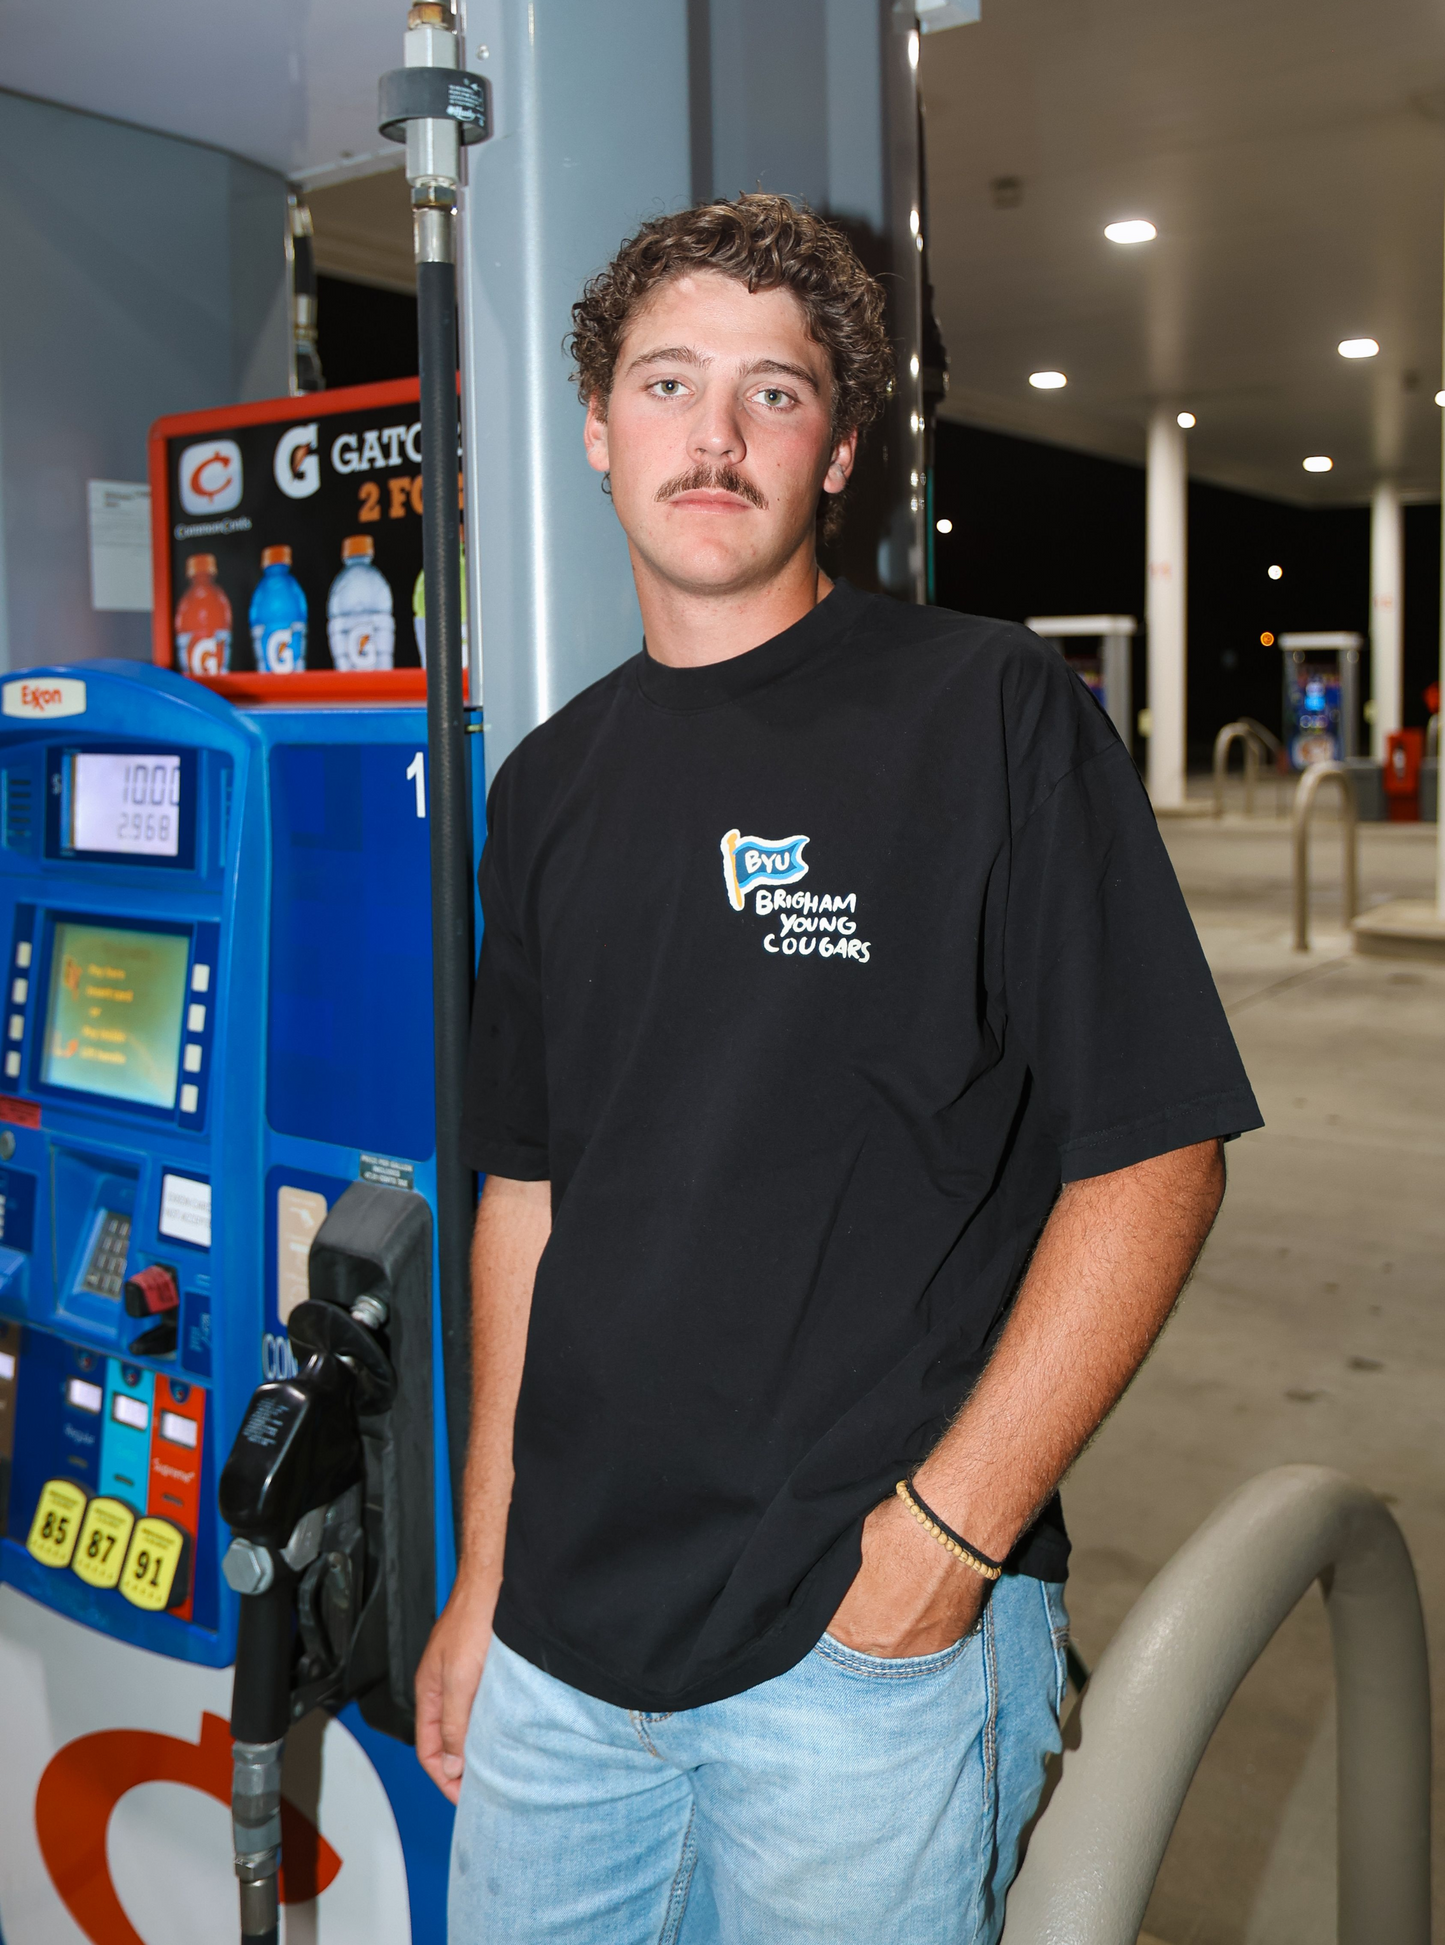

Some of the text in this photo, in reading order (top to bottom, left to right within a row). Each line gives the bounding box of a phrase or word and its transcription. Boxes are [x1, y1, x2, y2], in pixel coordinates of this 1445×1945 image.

[358, 481, 381, 523] 2
[266, 628, 294, 674] G
[21, 685, 62, 712] Exxon
[406, 751, 426, 818] 1
[744, 850, 790, 873] BYU
[756, 889, 857, 915] BRIGHAM
[780, 913, 857, 937] YOUNG
[763, 933, 872, 963] COUGARS
[42, 1512, 68, 1545] 85
[87, 1530, 115, 1564] 87
[134, 1550, 162, 1587] 91
